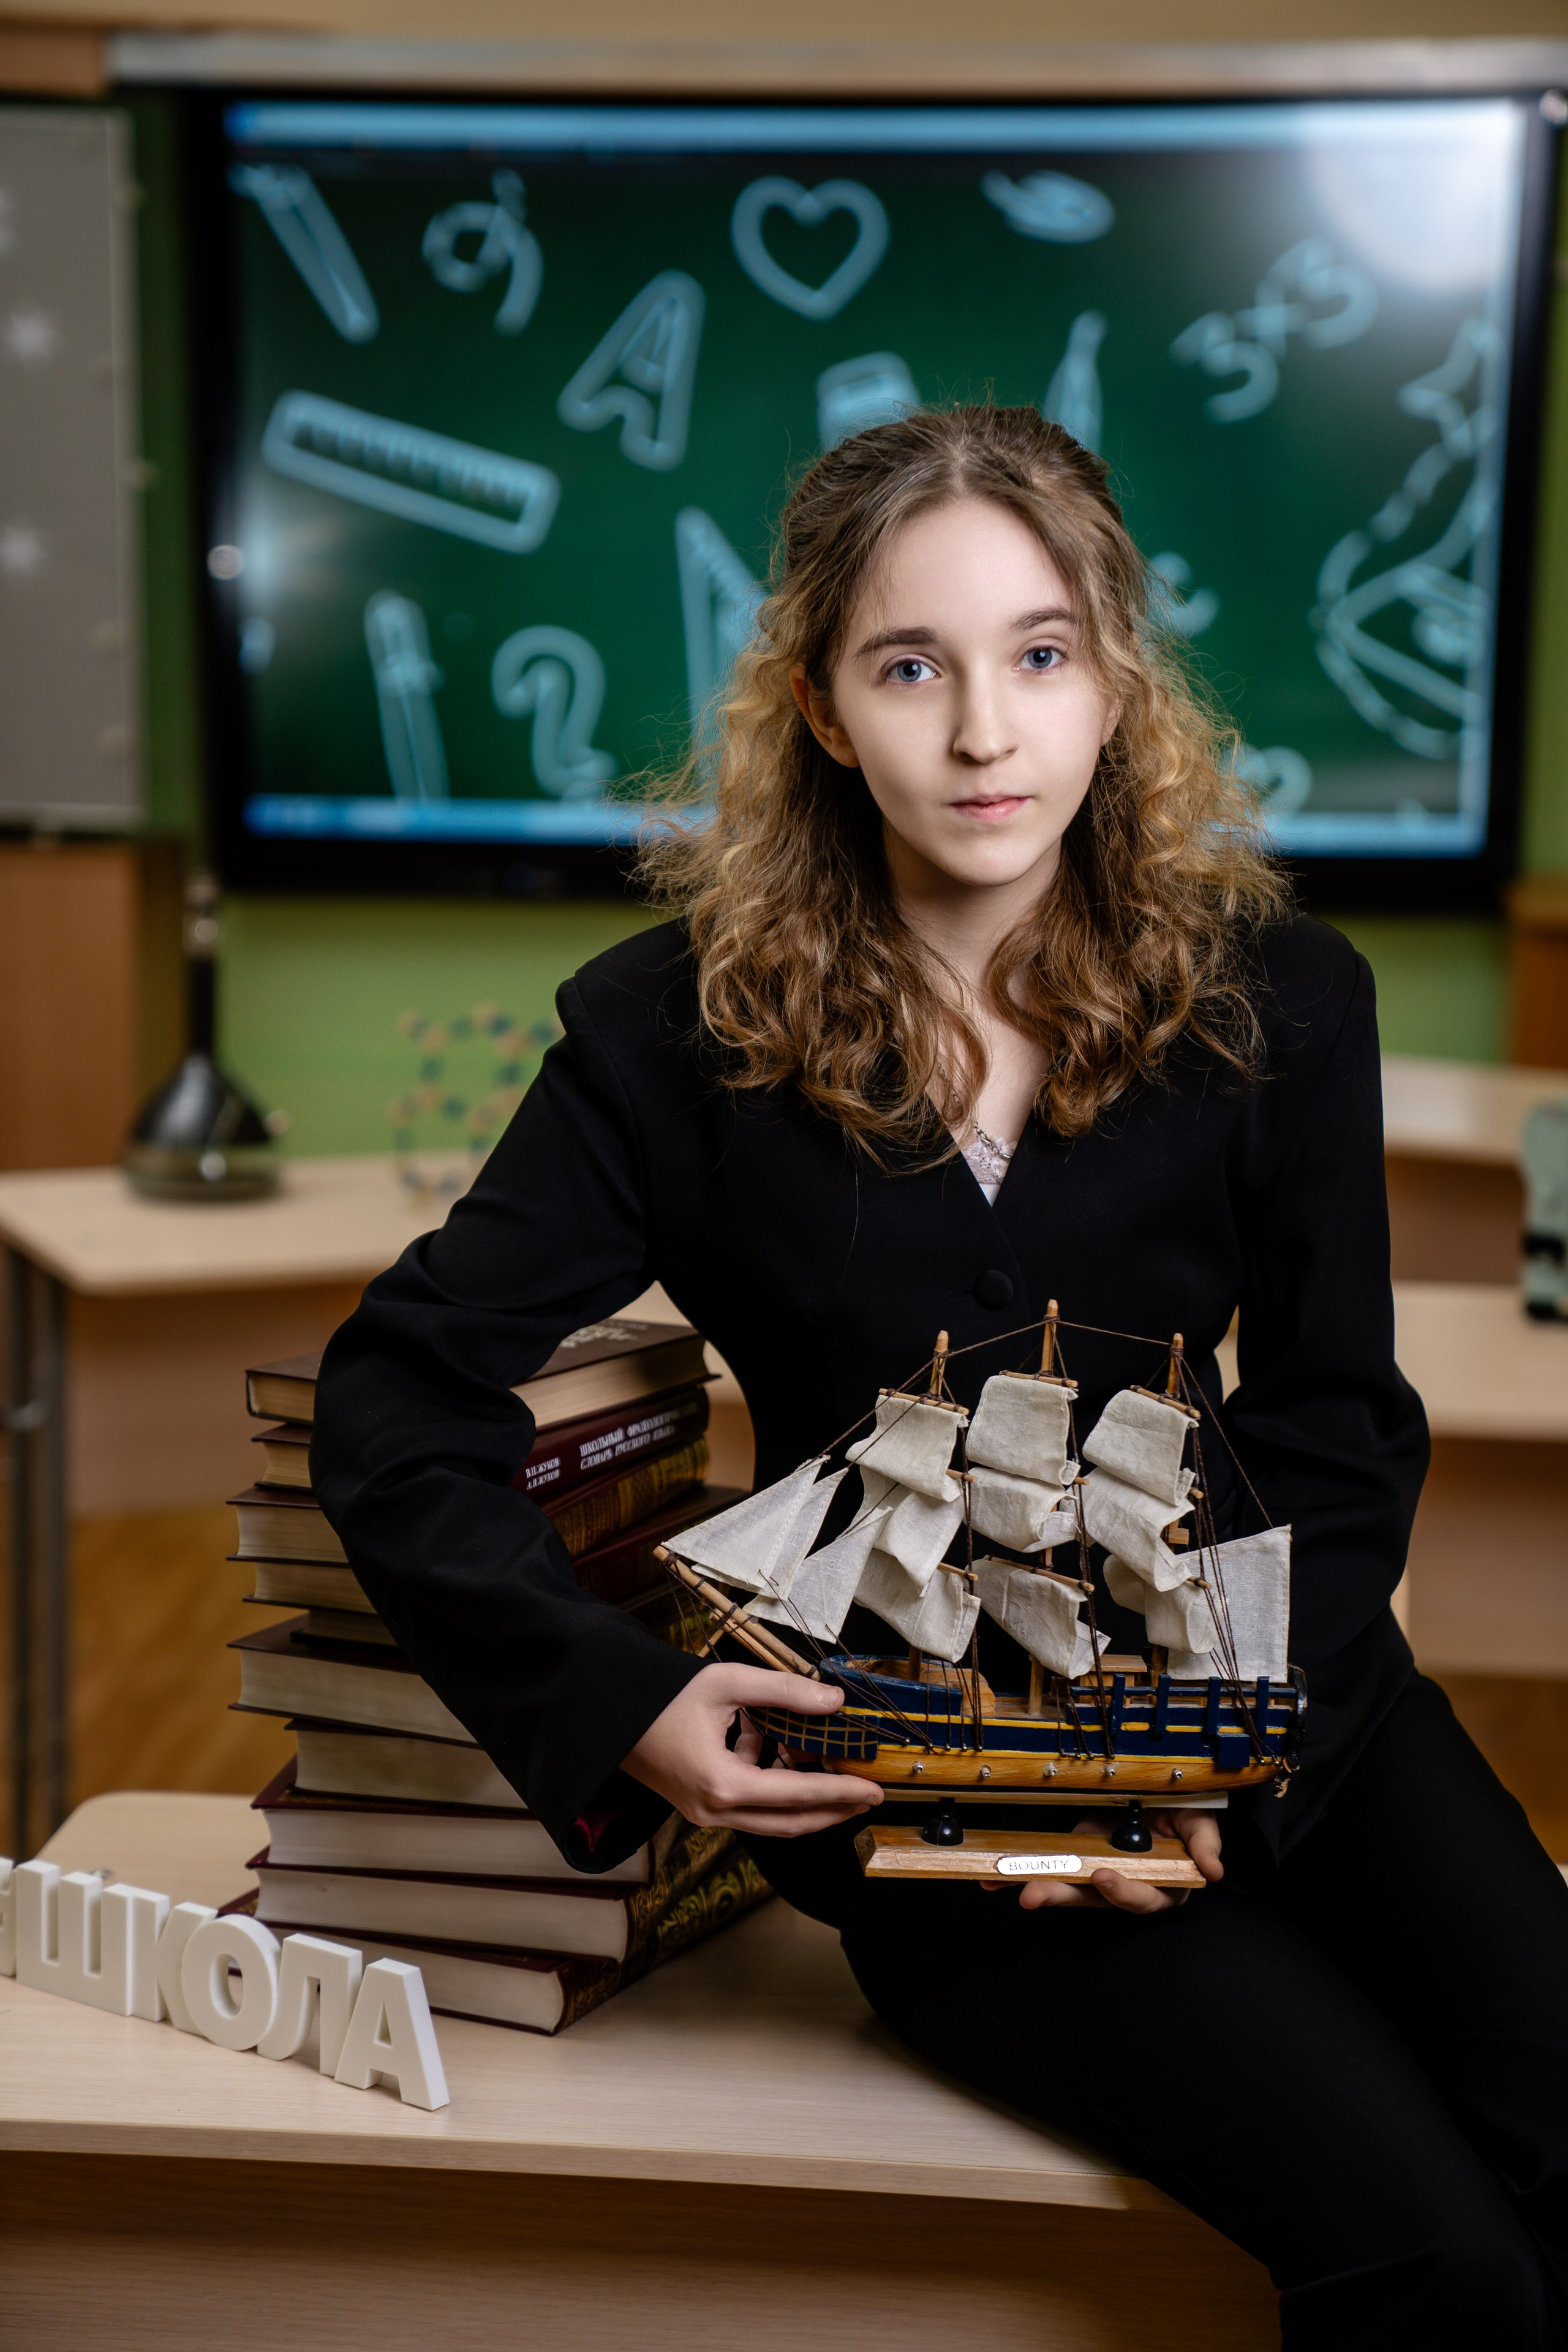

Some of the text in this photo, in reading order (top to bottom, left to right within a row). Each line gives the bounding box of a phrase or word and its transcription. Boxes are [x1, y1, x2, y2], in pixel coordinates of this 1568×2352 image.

[579, 1402, 697, 1457] ШКОЛЬНЫЙ ФРАЗЕОЛОГИЧ
[580, 1448, 612, 1469] СЛОВАРЬ
[614, 1432, 651, 1457] РУССКОГО
[1009, 1860, 1069, 1871] BOUNTY
